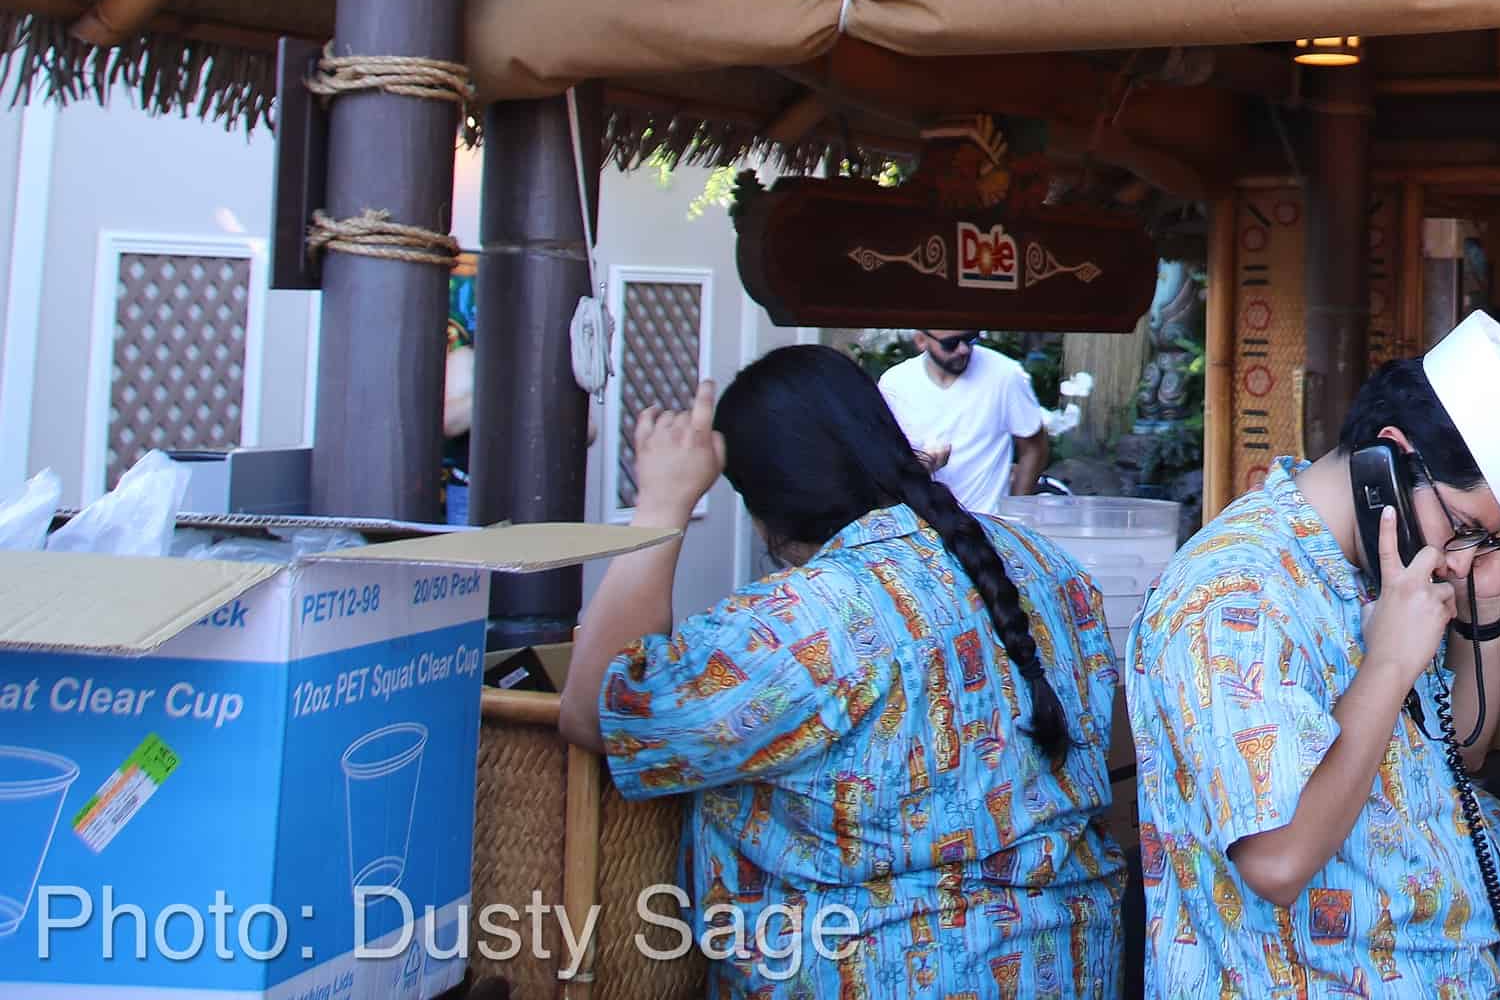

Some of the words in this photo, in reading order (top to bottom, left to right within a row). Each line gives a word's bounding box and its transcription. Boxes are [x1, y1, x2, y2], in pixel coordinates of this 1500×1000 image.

[961, 229, 1015, 273] Dole
[302, 584, 381, 624] PET12-98
[413, 575, 448, 604] 20/50
[450, 570, 481, 597] Pack
[50, 676, 155, 715] Clear
[165, 681, 244, 728] Cup
[293, 681, 332, 717] 12oz
[335, 667, 370, 707] PET
[372, 657, 415, 702] Squat
[418, 651, 453, 685] Clear
[455, 644, 480, 679] Cup
